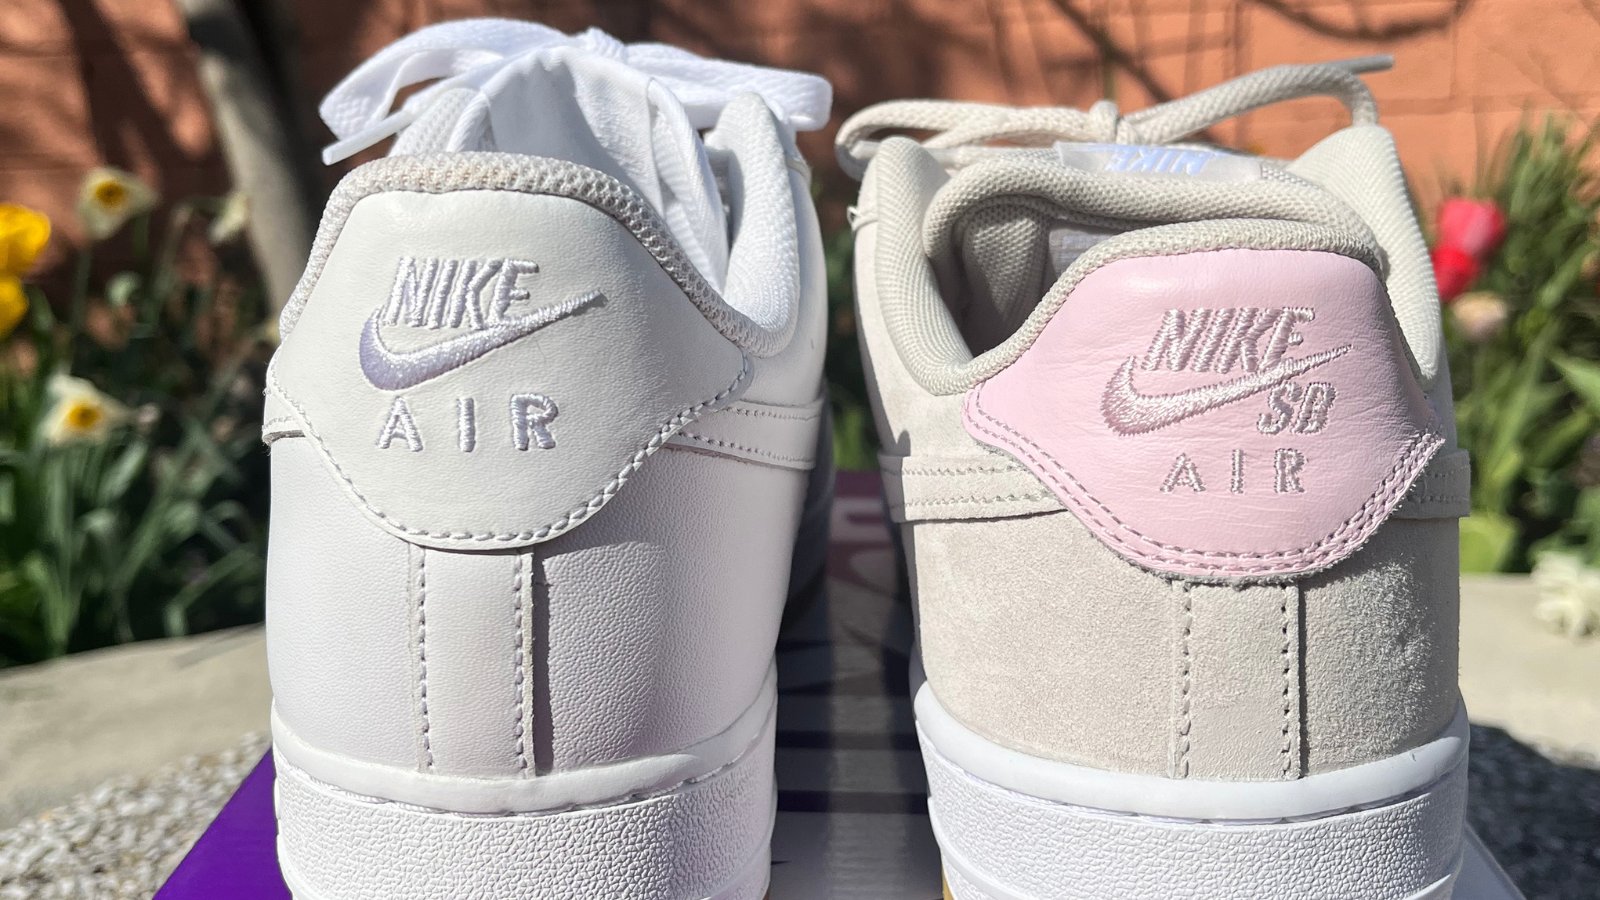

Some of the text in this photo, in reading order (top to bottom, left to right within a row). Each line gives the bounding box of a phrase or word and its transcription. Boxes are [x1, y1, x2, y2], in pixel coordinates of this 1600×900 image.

[1104, 146, 1213, 176] NIKE
[385, 257, 540, 331] NIKE
[1141, 307, 1316, 374] NIKE
[375, 393, 559, 452] AIR
[1256, 382, 1337, 435] SB
[1159, 448, 1307, 494] AIR
